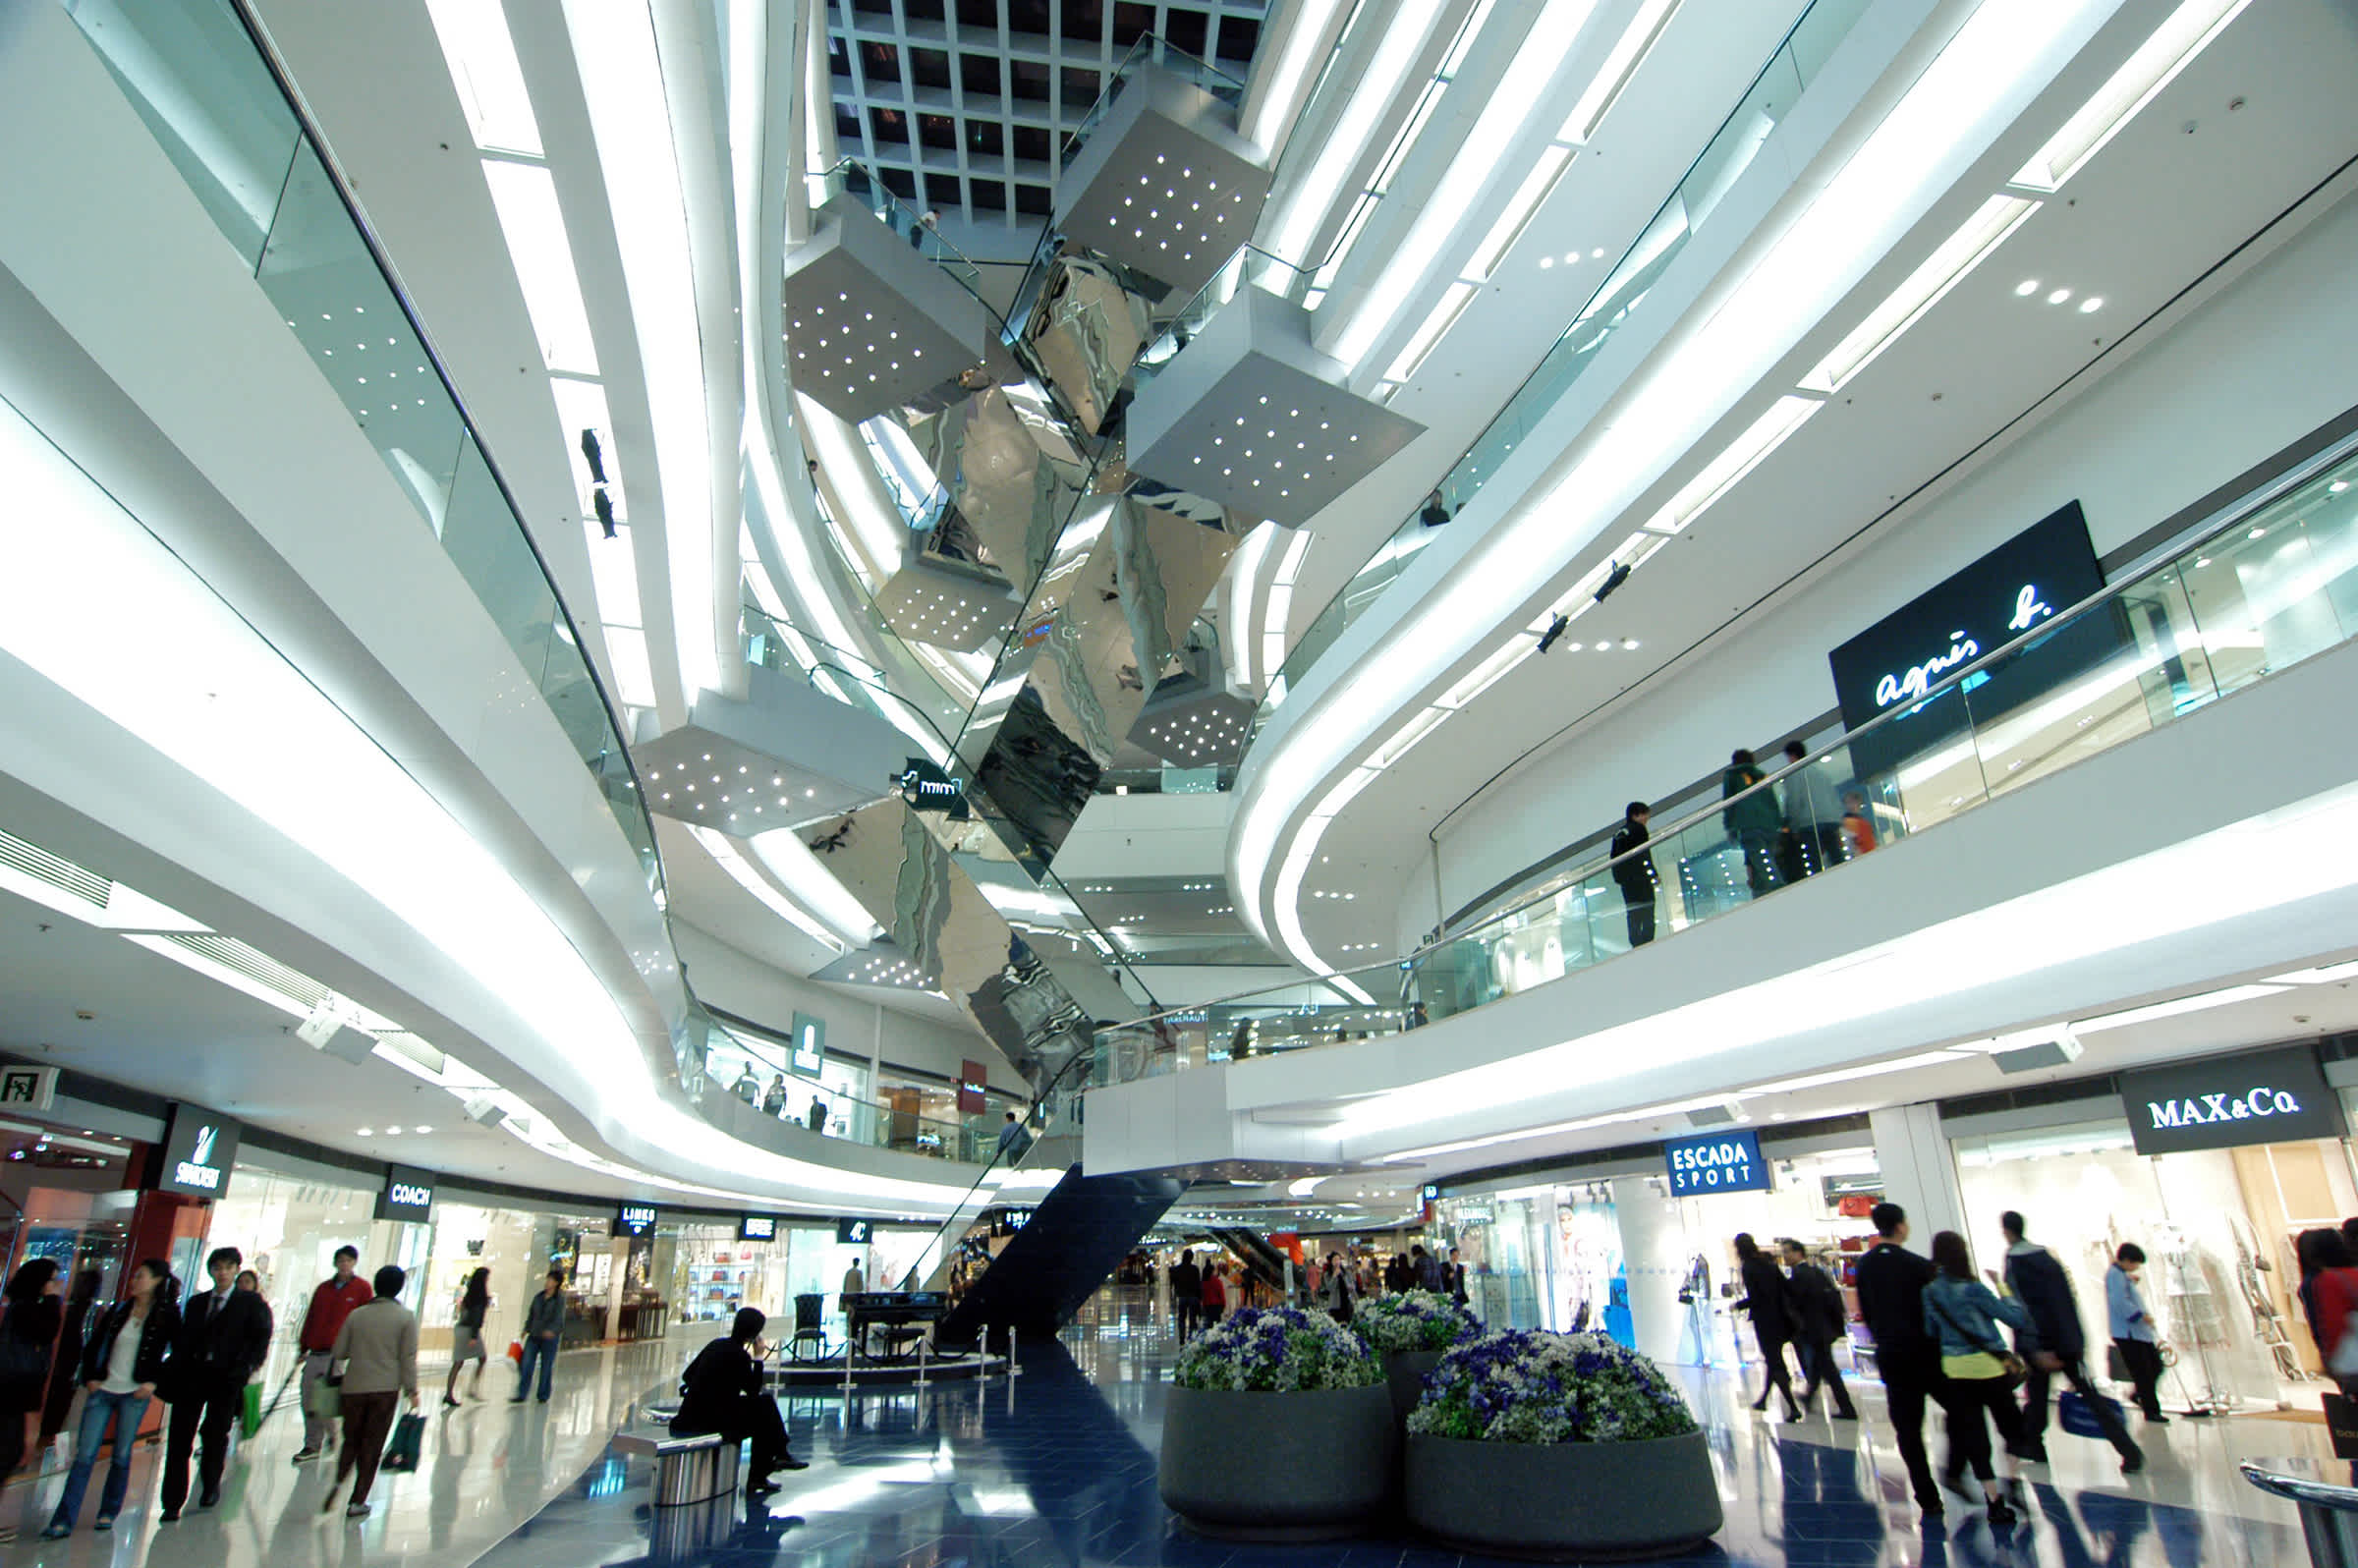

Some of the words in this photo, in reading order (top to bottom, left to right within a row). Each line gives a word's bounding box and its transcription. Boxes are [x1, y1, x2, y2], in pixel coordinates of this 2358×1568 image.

[1672, 1142, 1749, 1171] ESCADA
[1676, 1165, 1750, 1189] SPORT
[391, 1183, 431, 1206] COACH
